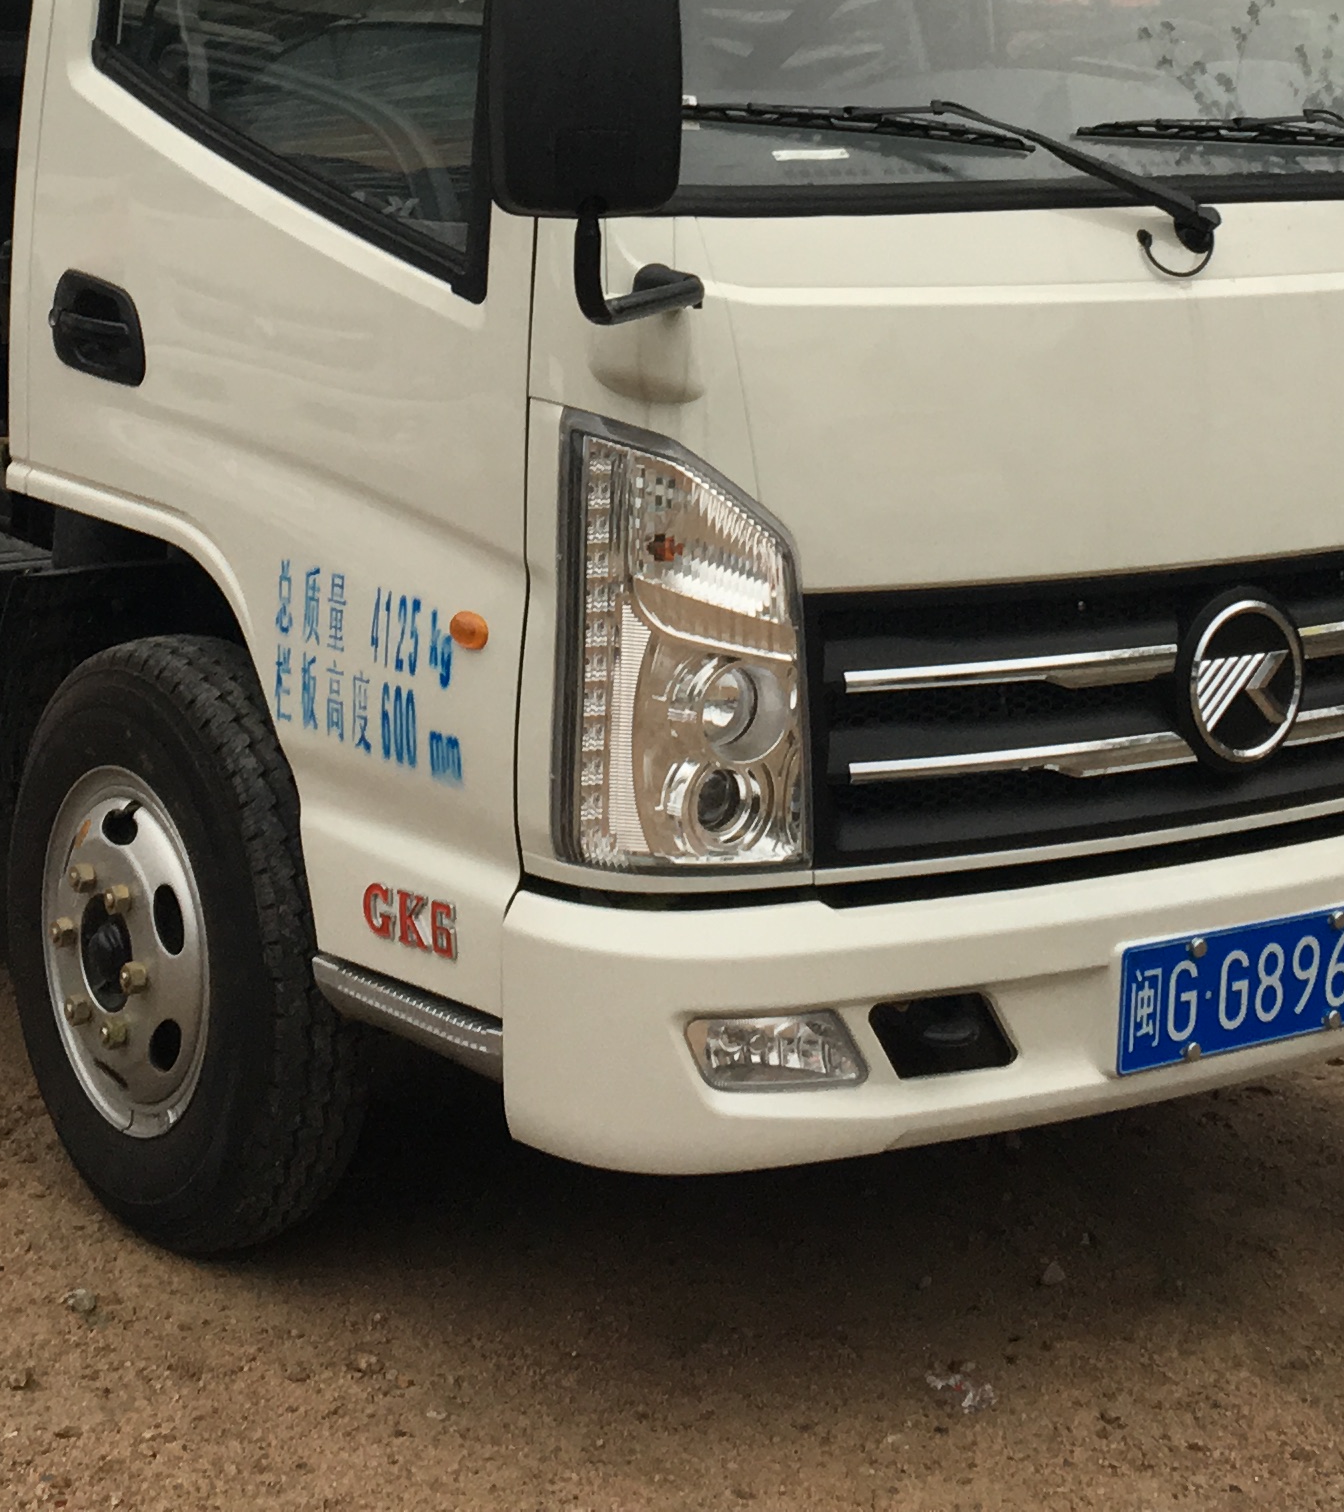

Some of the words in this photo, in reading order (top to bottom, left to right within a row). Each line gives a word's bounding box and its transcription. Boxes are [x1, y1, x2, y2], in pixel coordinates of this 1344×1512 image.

[274, 558, 347, 653] 总质量
[370, 586, 422, 677] 4125
[274, 643, 372, 754] 栏板高度
[380, 681, 418, 769] 600
[362, 882, 458, 962] GK6
